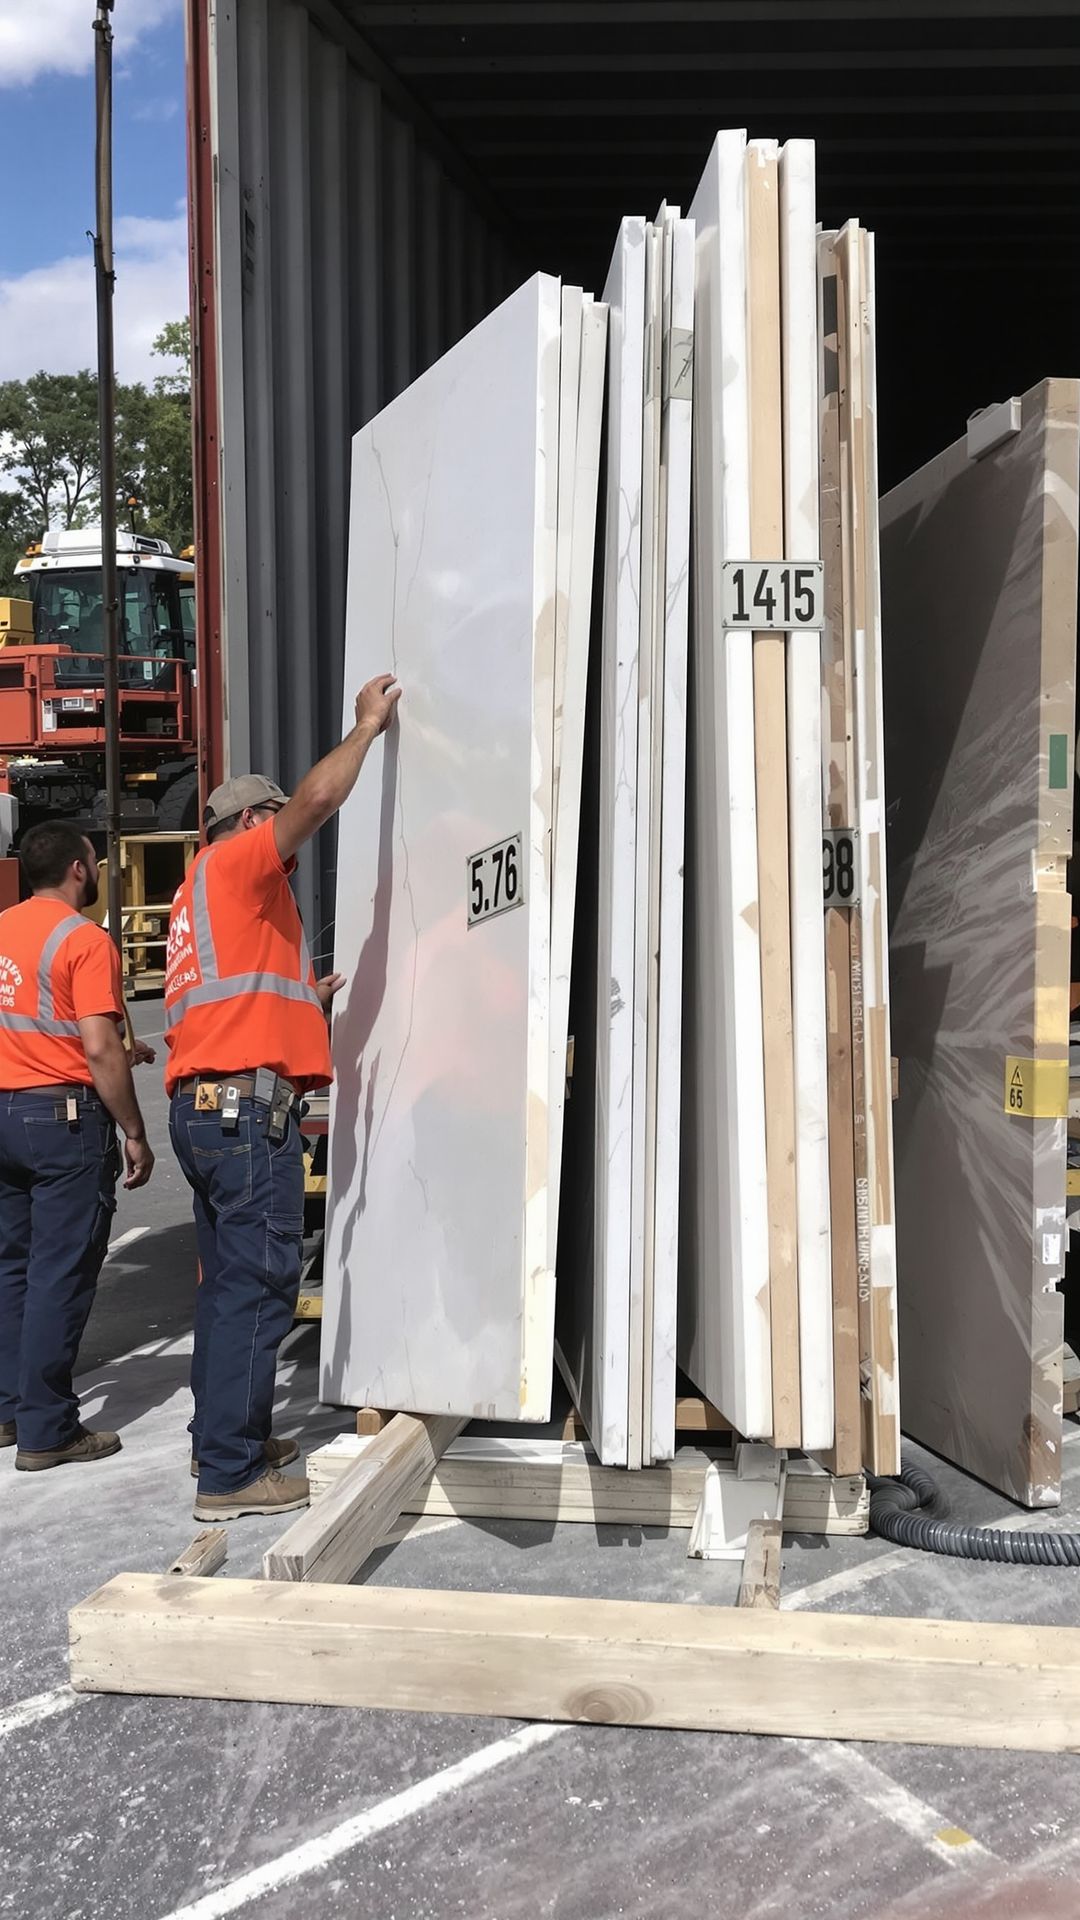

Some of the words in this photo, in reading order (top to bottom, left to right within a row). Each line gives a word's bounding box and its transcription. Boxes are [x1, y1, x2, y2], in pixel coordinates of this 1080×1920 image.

[732, 569, 815, 622] 1415
[472, 844, 517, 915] 5.76
[1009, 1088, 1023, 1109] 65
